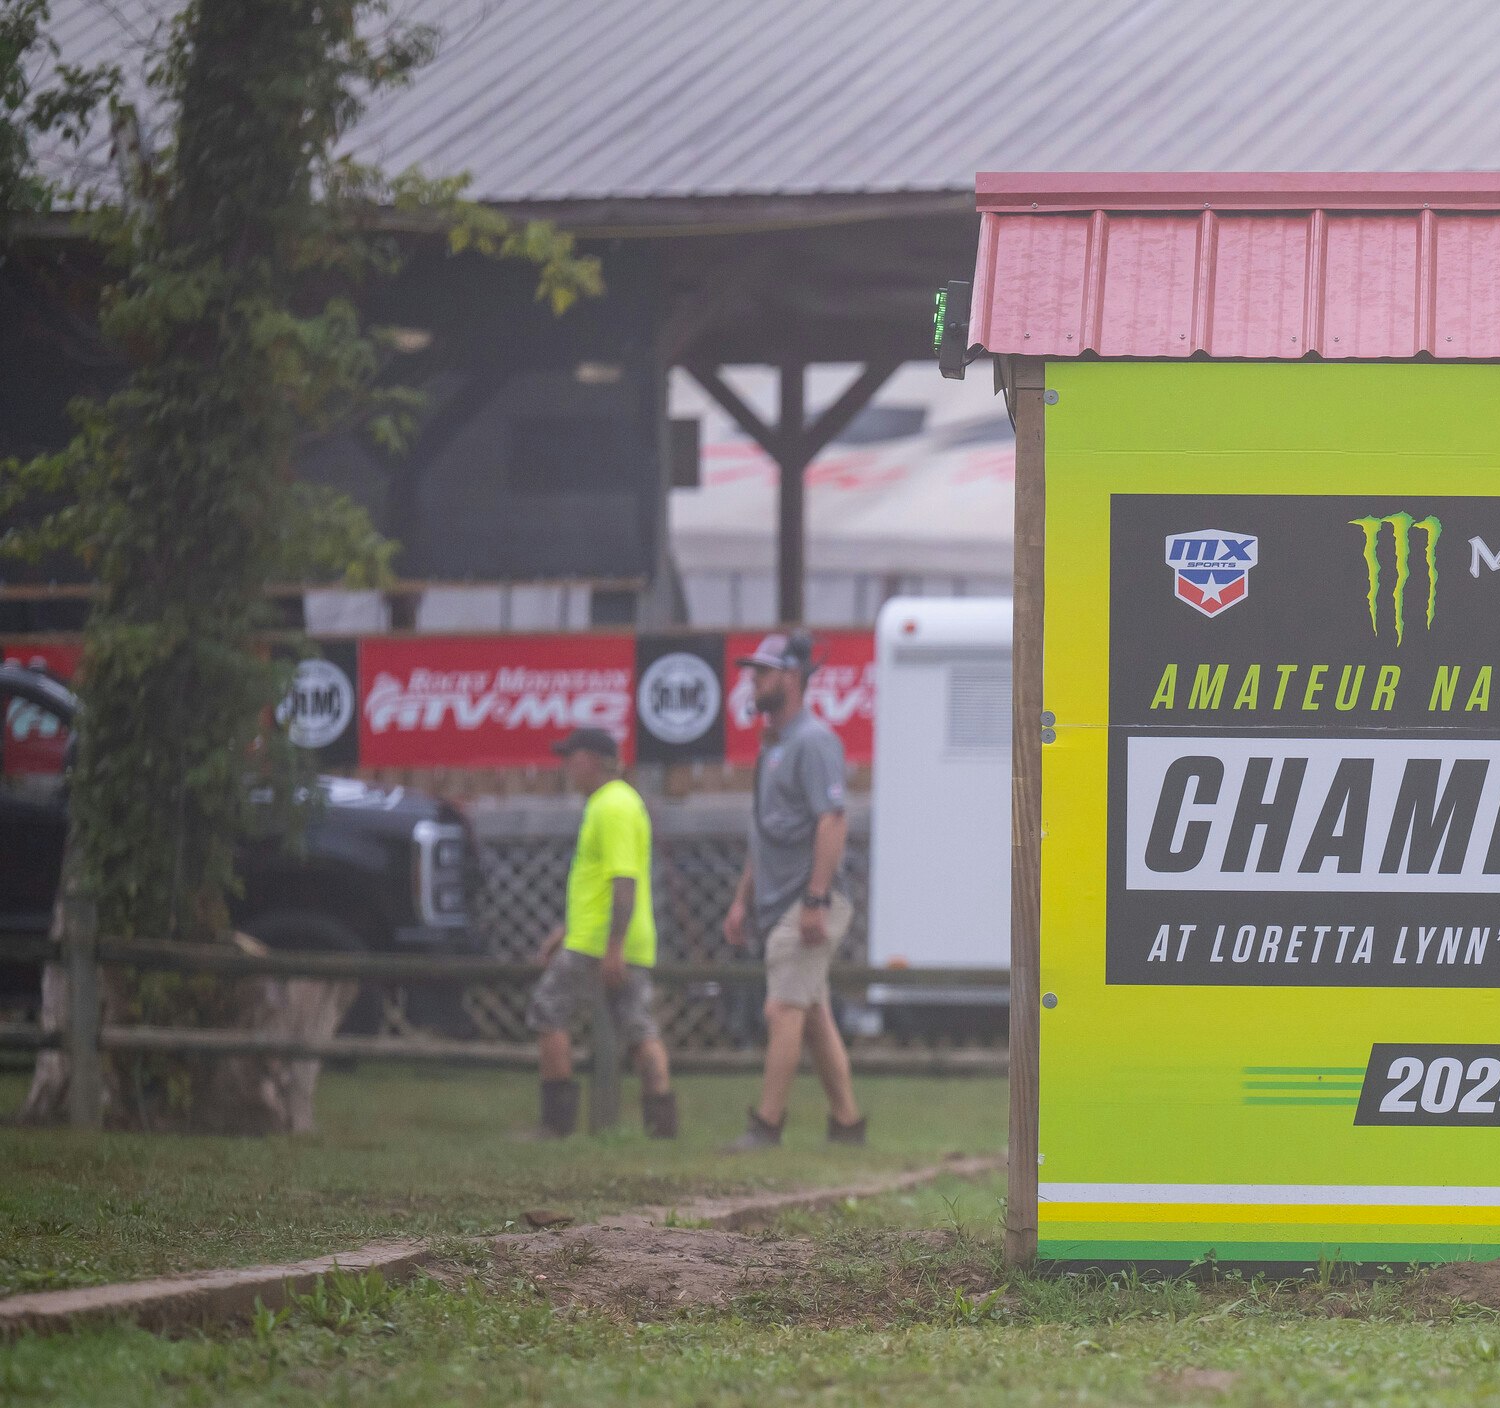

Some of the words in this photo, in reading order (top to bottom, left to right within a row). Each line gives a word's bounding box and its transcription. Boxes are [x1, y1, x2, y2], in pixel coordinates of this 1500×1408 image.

[1169, 539, 1256, 561] MX
[1150, 664, 1402, 711] AMATEUR
[1147, 924, 1197, 962] AT
[1210, 924, 1375, 964] LORETTA
